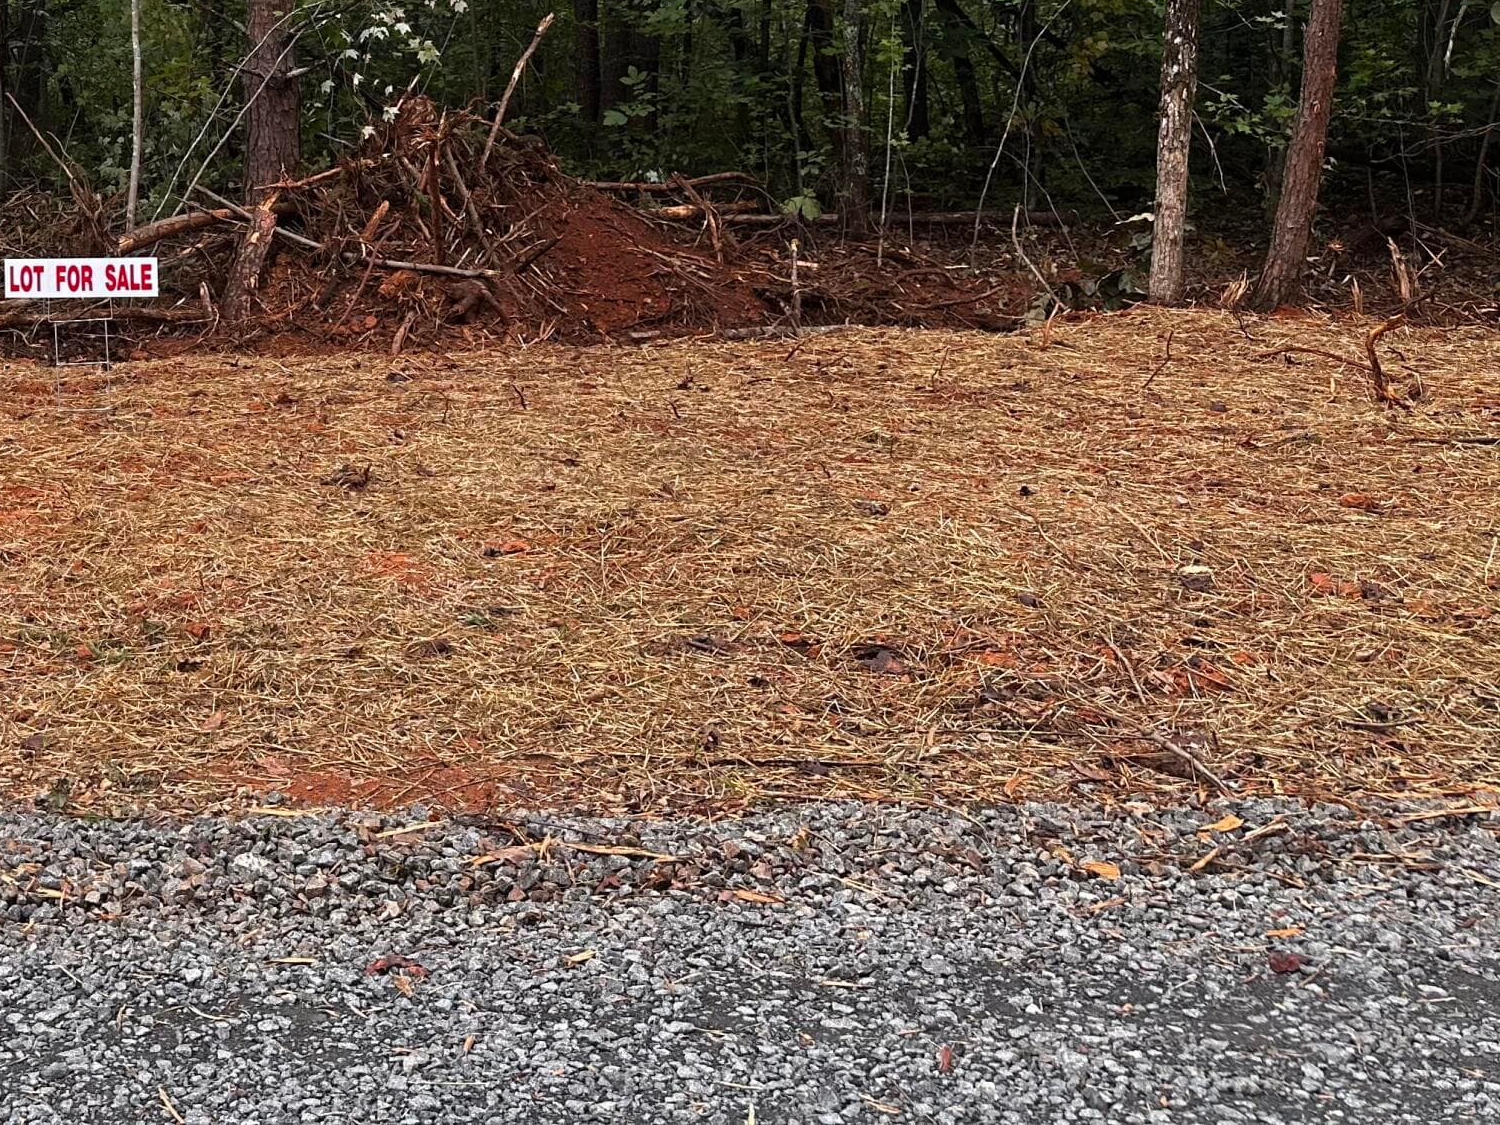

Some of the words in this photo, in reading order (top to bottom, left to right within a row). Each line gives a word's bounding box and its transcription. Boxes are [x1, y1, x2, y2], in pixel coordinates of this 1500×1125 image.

[9, 265, 45, 292] LOT
[55, 265, 93, 292] FOR
[104, 263, 153, 292] SALE
